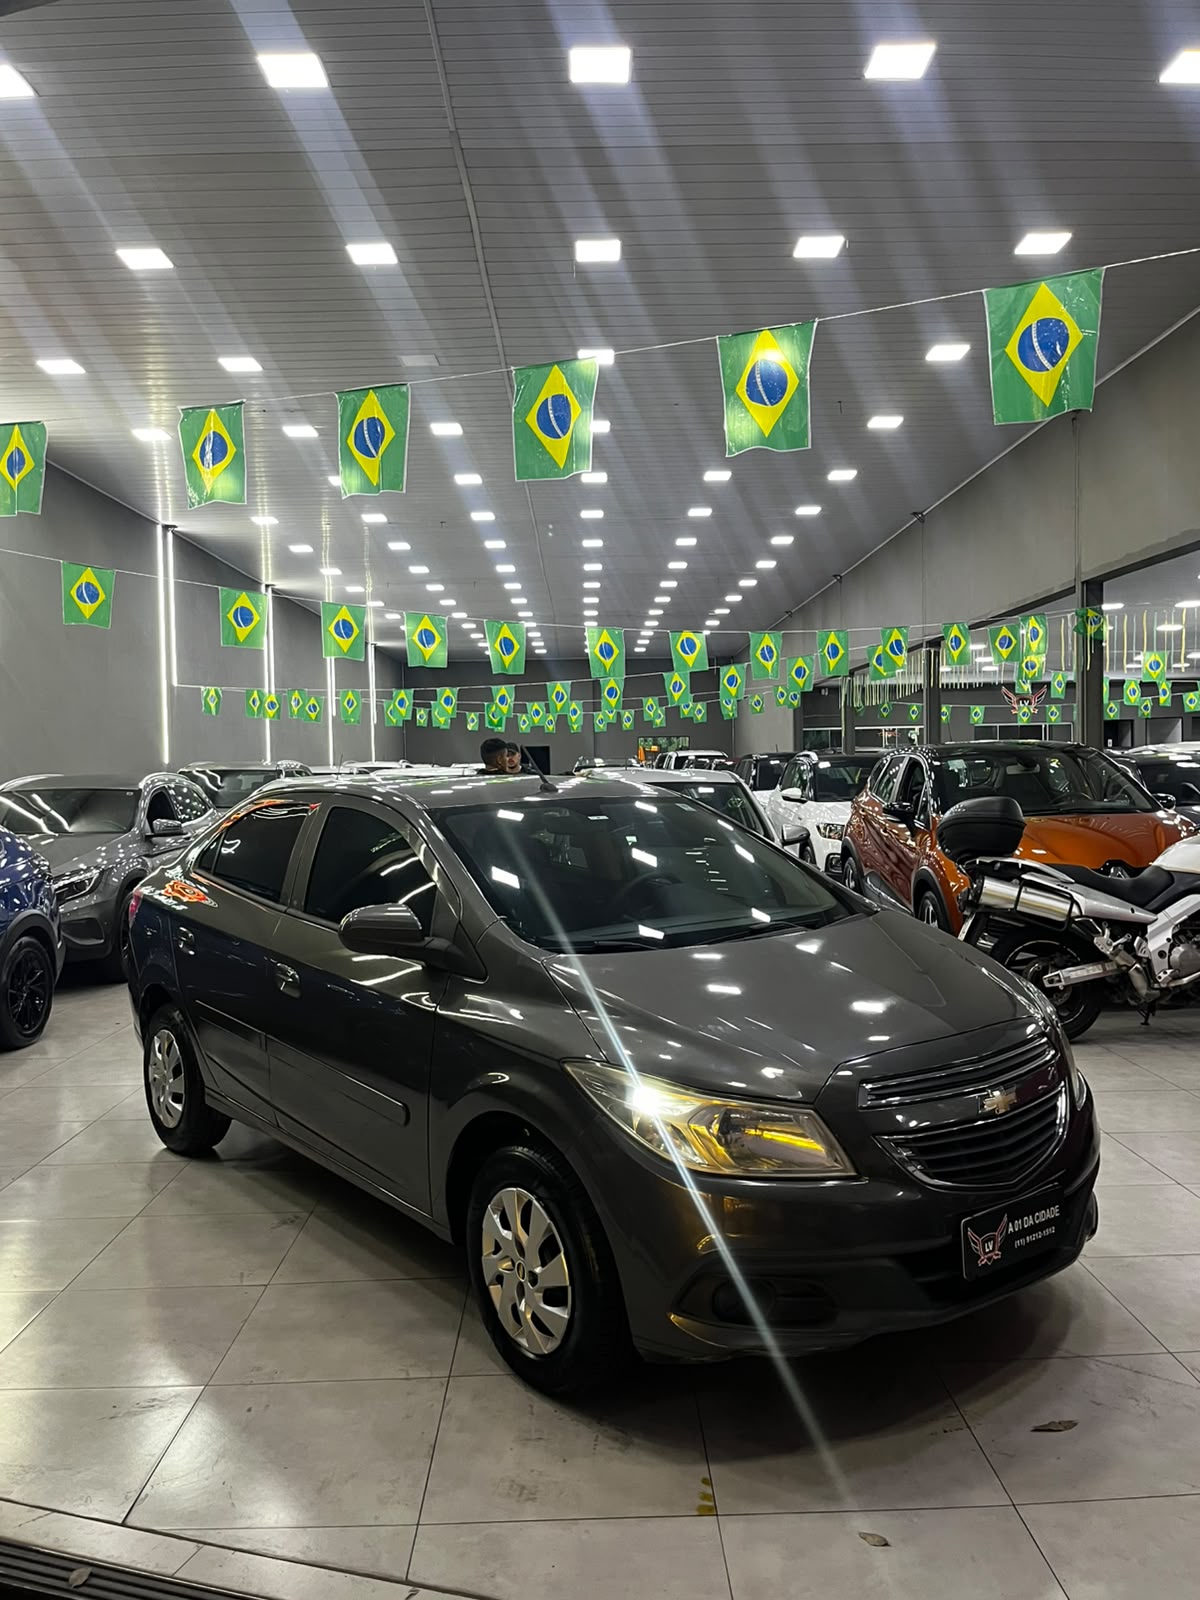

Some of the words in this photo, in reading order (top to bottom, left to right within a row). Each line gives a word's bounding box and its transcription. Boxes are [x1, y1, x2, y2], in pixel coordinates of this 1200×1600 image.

[1008, 1221, 1014, 1234] A
[1014, 1218, 1022, 1232] 01
[1023, 1215, 1034, 1228] DA
[1034, 1205, 1060, 1223] CIDADE
[985, 1240, 993, 1252] LV
[1014, 1237, 1026, 1248] (11)
